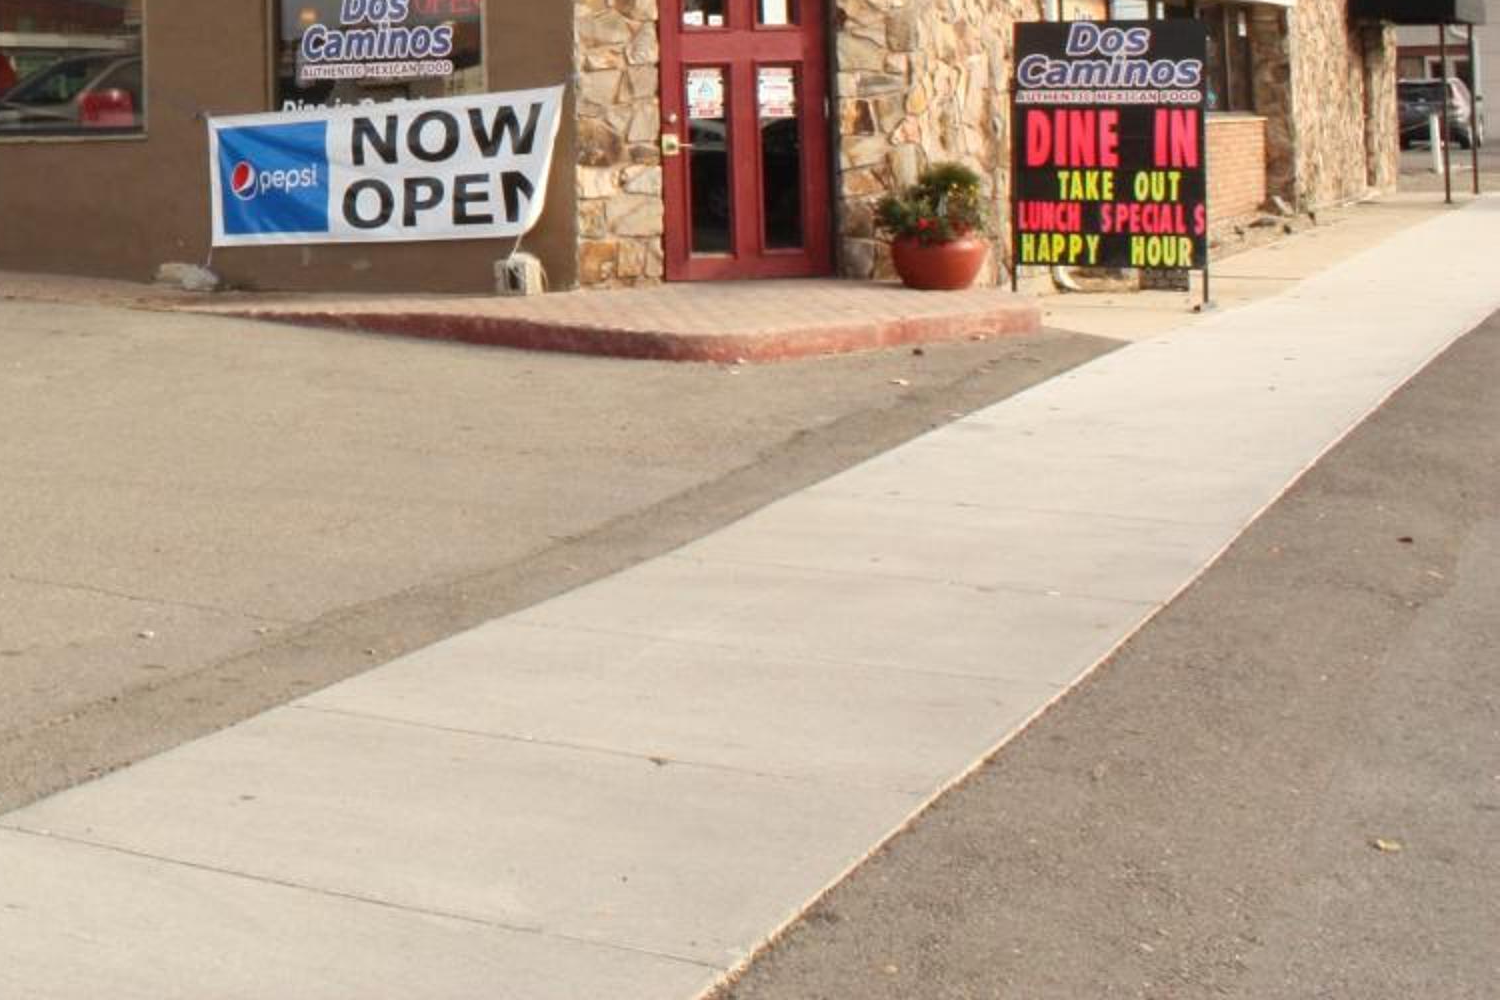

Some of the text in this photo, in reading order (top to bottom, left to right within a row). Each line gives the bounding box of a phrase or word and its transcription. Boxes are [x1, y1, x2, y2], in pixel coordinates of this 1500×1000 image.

[302, 21, 453, 62] Caminos
[1066, 22, 1150, 55] Dos
[302, 60, 452, 78] AUTHENTIC MEXICAN FOOD
[1018, 53, 1202, 88] Caminos
[1017, 90, 1202, 103] AUTHENTIC MEXICAN FOOD
[351, 102, 545, 166] NOW
[1027, 109, 1198, 167] DINE IN
[260, 164, 318, 195] pepsi
[1058, 171, 1181, 201] TAKE OUT
[341, 171, 536, 230] OPEN
[1019, 203, 1081, 231] LUNCH
[1022, 234, 1192, 266] HAPPY HOUR
